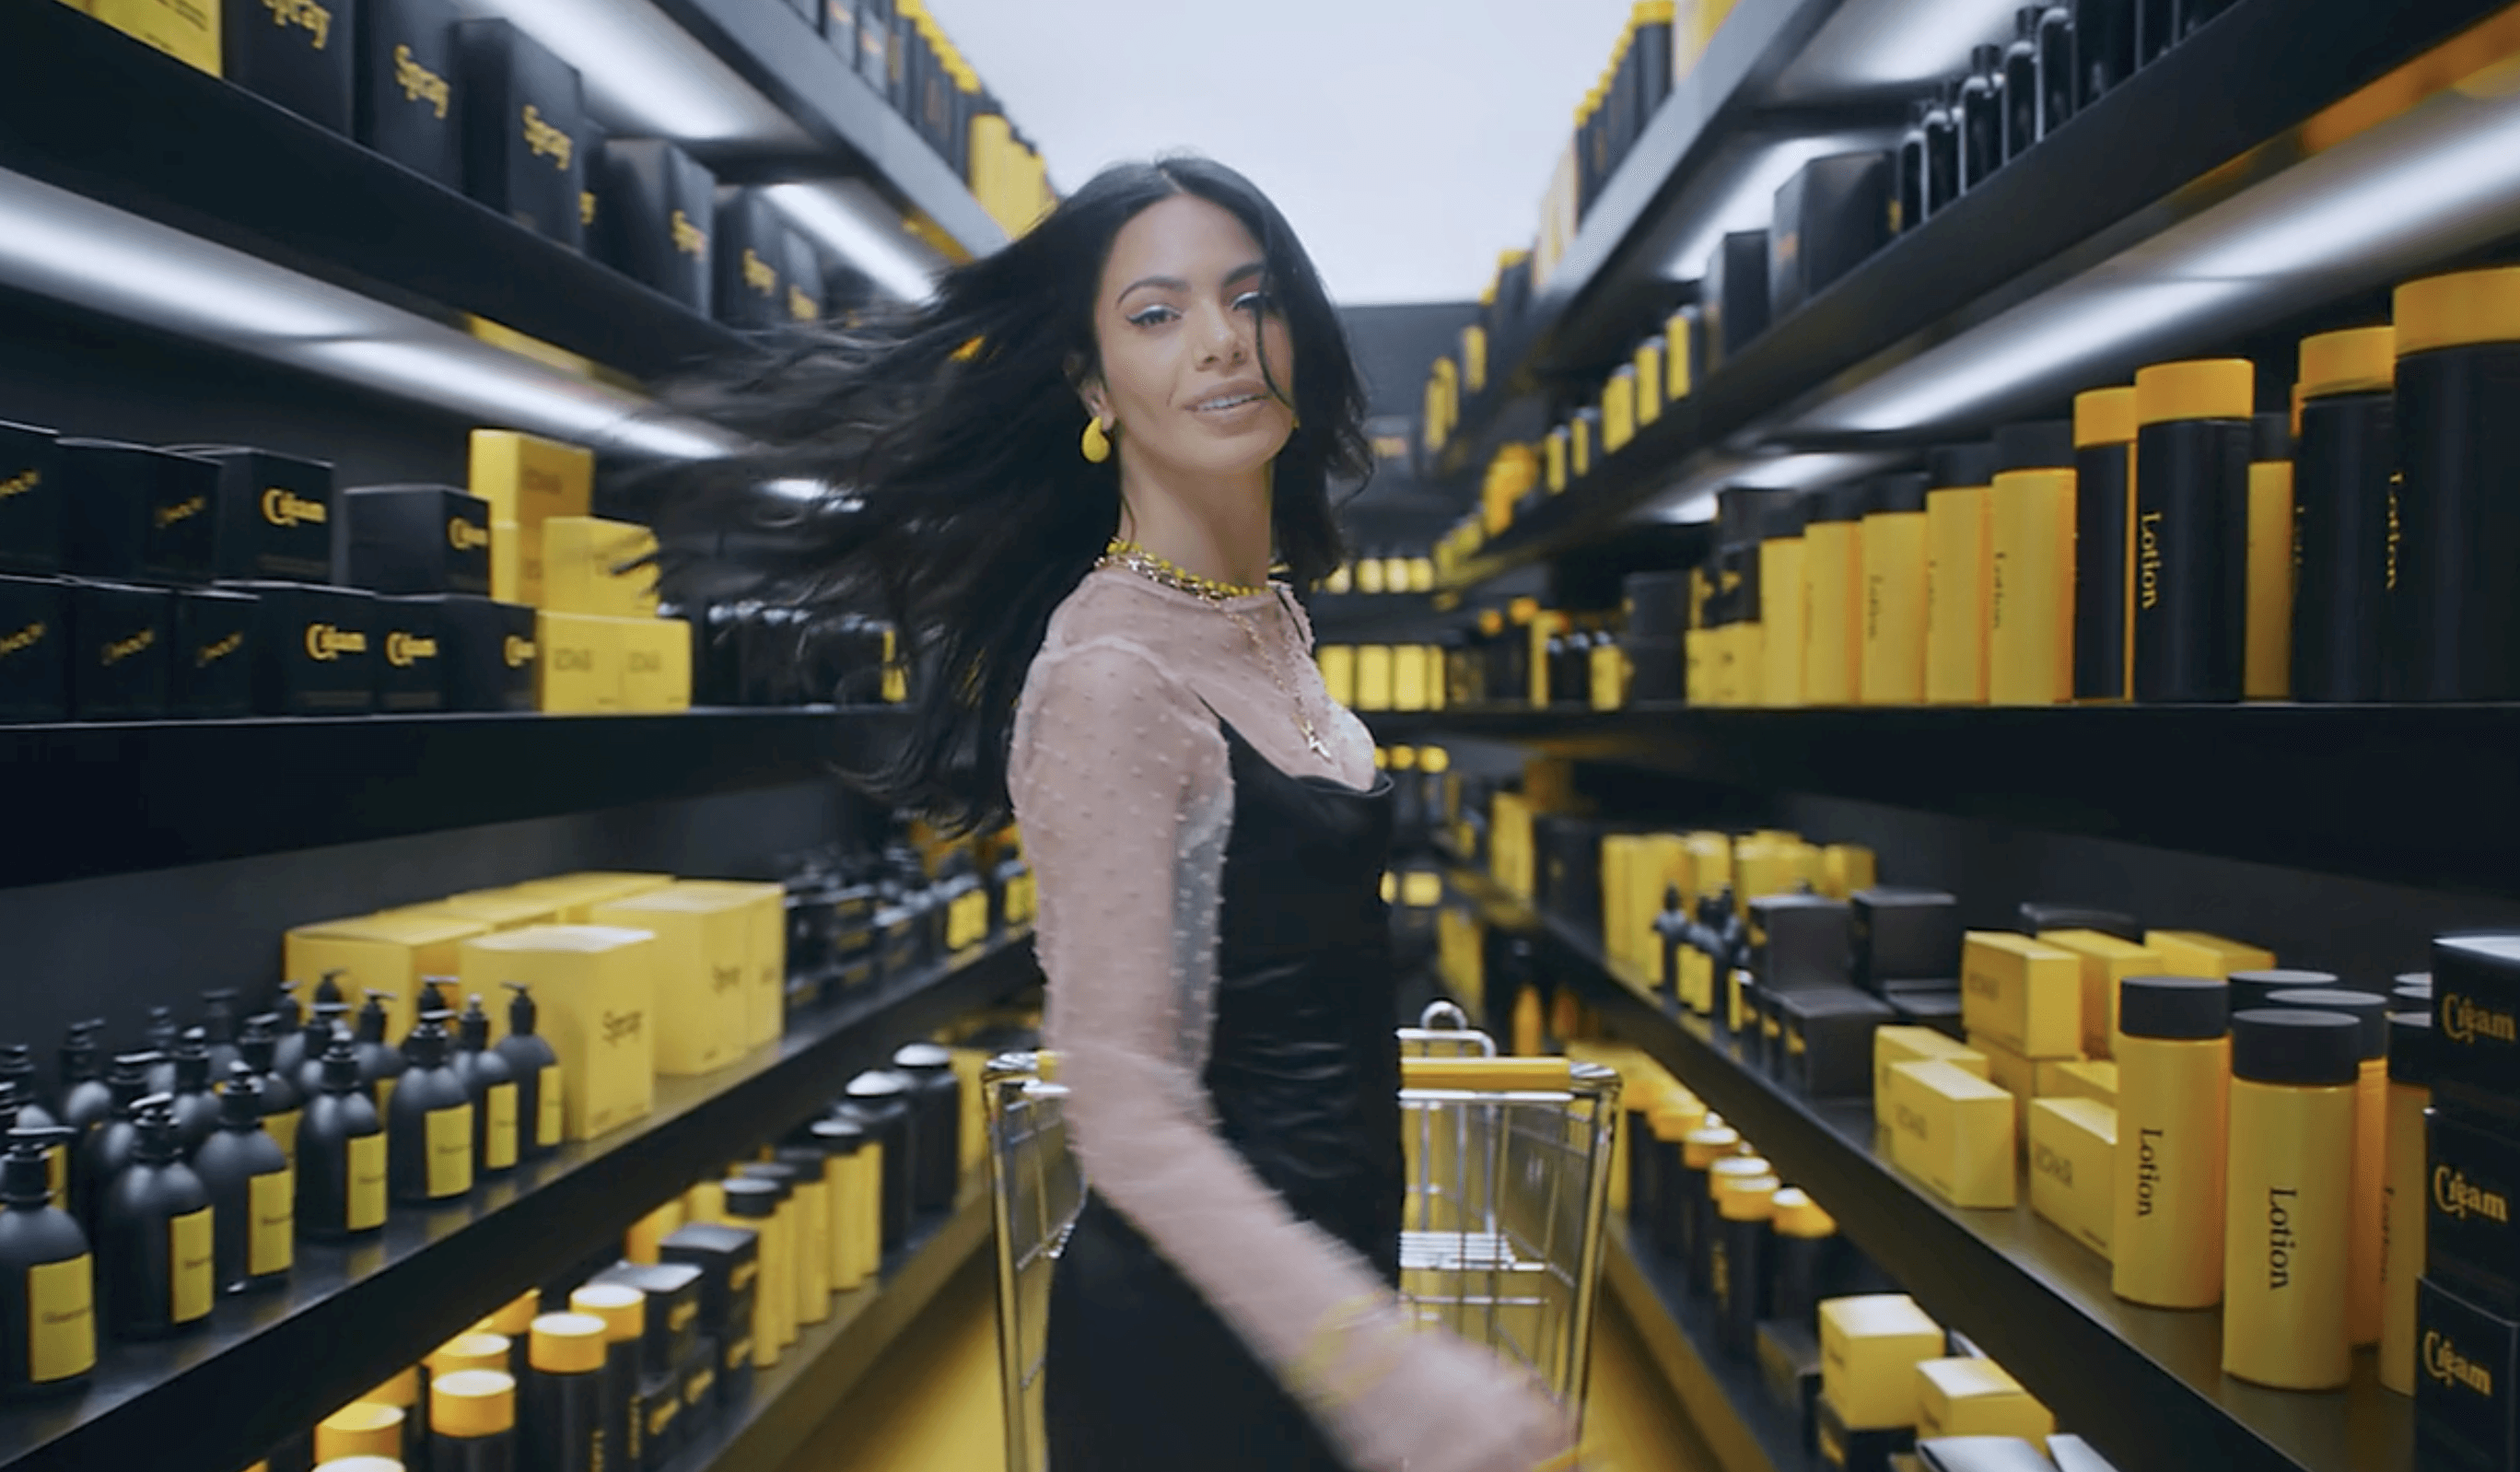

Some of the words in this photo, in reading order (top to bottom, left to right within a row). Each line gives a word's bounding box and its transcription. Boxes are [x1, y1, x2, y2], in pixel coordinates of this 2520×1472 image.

[262, 0, 331, 50] pray
[394, 43, 449, 120] Spray
[522, 104, 573, 171] Spray
[2141, 511, 2163, 609] Lotion
[2442, 992, 2515, 1045] Cream
[2137, 1127, 2164, 1218] Lotion
[2433, 1164, 2507, 1222] Cream
[2269, 1186, 2299, 1290] Lotion
[2422, 1330, 2492, 1396] Cream
